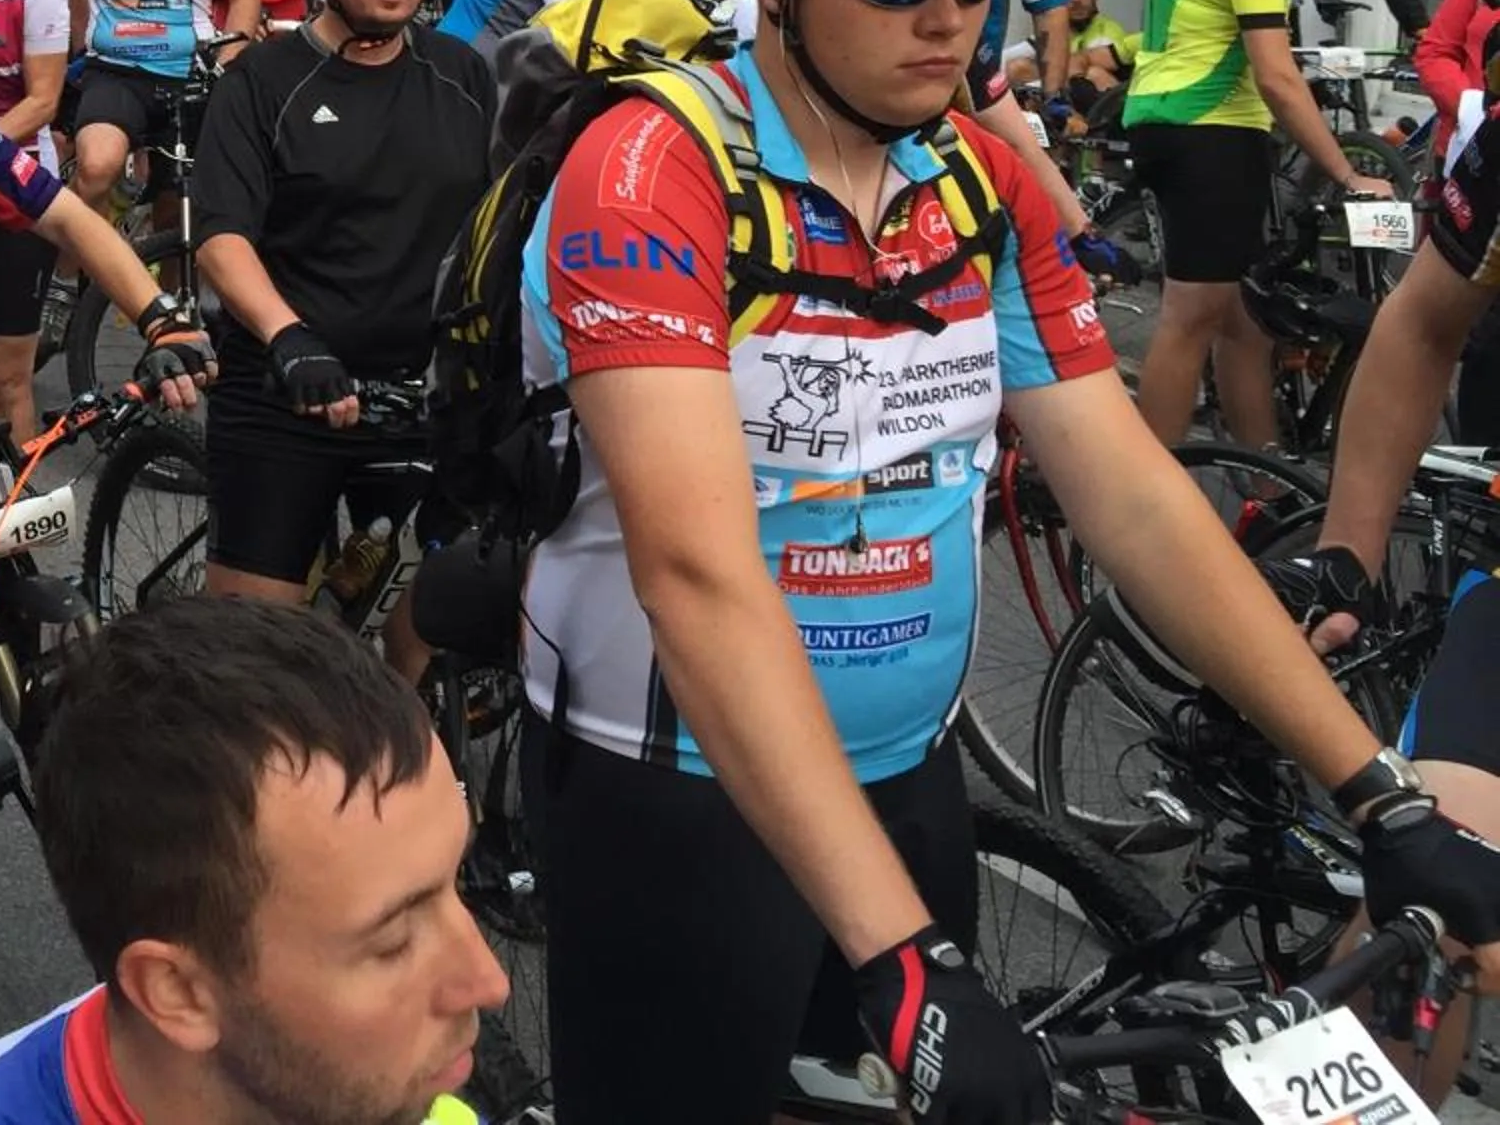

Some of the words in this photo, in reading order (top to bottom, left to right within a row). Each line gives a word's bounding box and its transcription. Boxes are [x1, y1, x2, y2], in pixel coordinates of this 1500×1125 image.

[1373, 214, 1407, 230] 1560
[876, 412, 947, 437] WILDON
[10, 510, 67, 544] 1890
[1285, 1052, 1383, 1118] 2126
